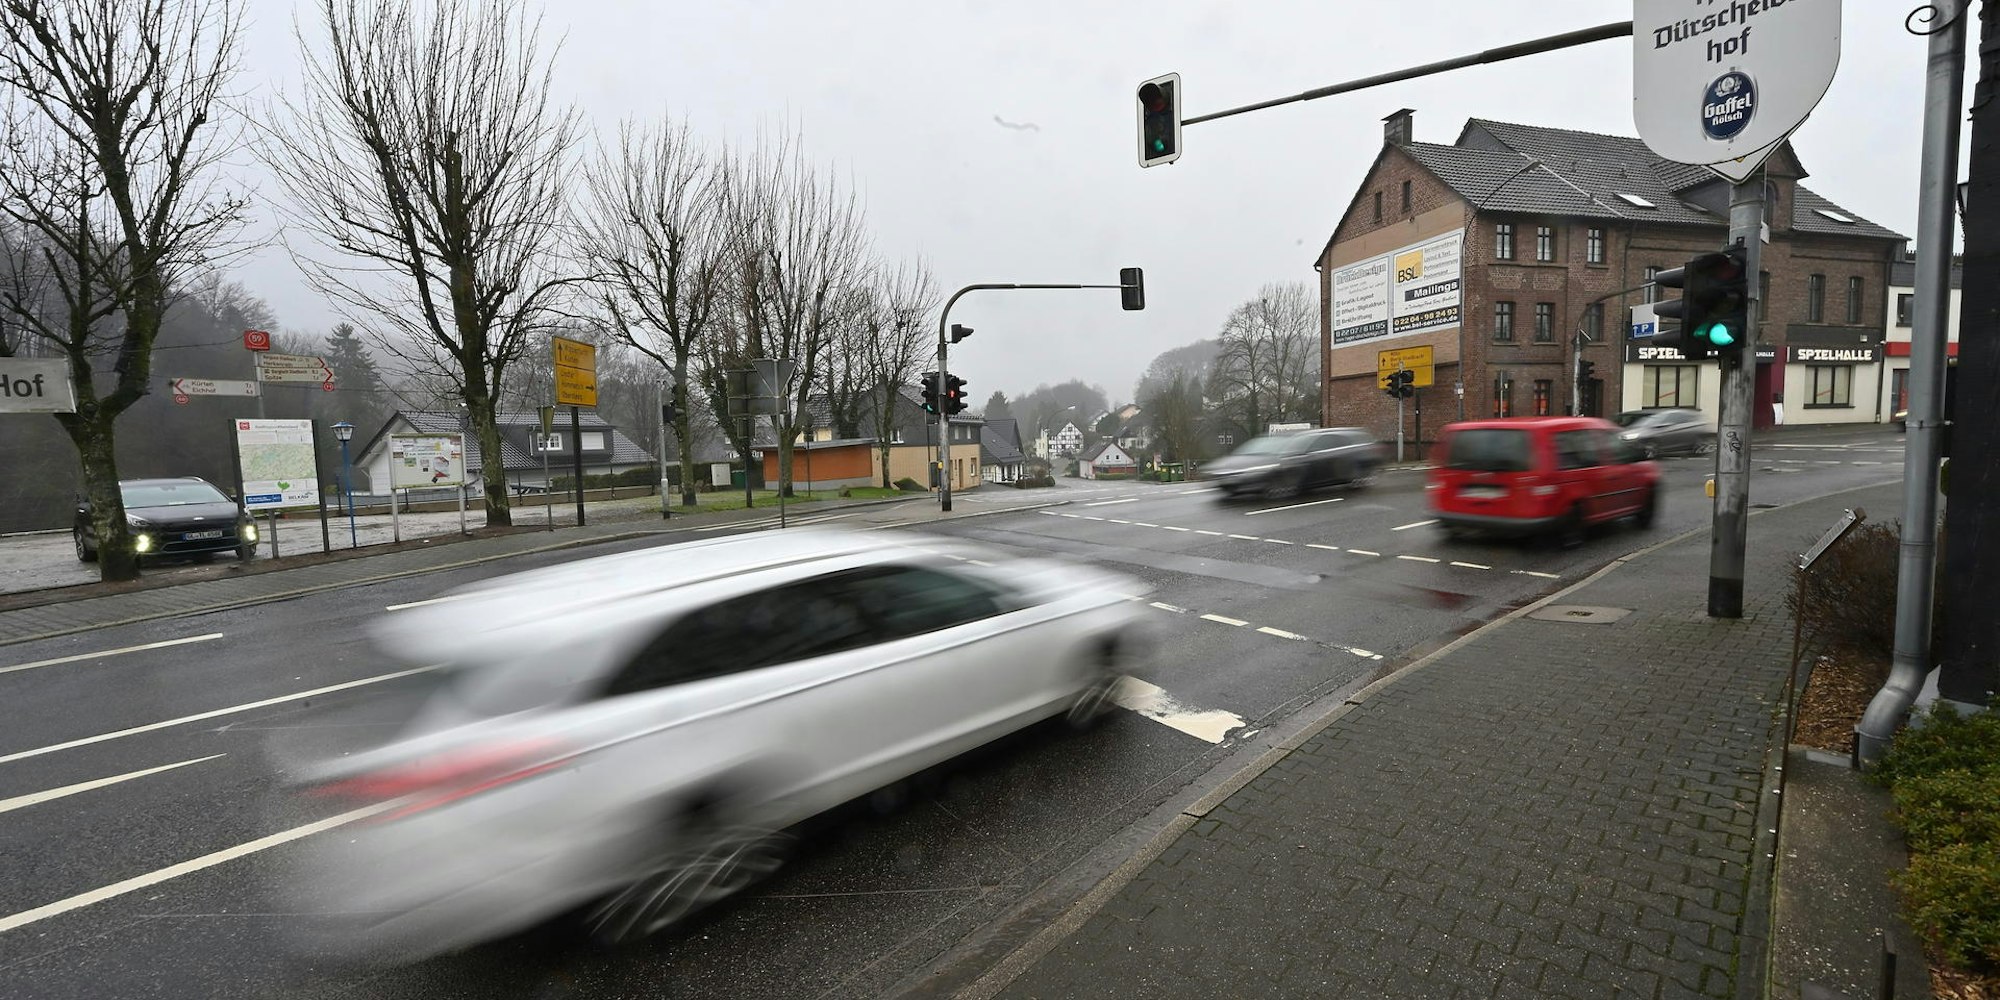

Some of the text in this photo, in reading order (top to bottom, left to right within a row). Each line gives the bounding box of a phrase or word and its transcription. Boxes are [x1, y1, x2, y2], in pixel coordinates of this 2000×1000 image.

[1707, 27, 1751, 63] hof
[1705, 92, 1752, 118] Gaffel
[1712, 110, 1743, 126] Kölsch
[1398, 266, 1418, 283] BSL
[1413, 281, 1458, 298] Mailings
[1641, 323, 1649, 333] P
[1639, 347, 1685, 359] SPIEL
[1798, 349, 1872, 360] SPIELHALLE
[0, 374, 44, 397] Hof
